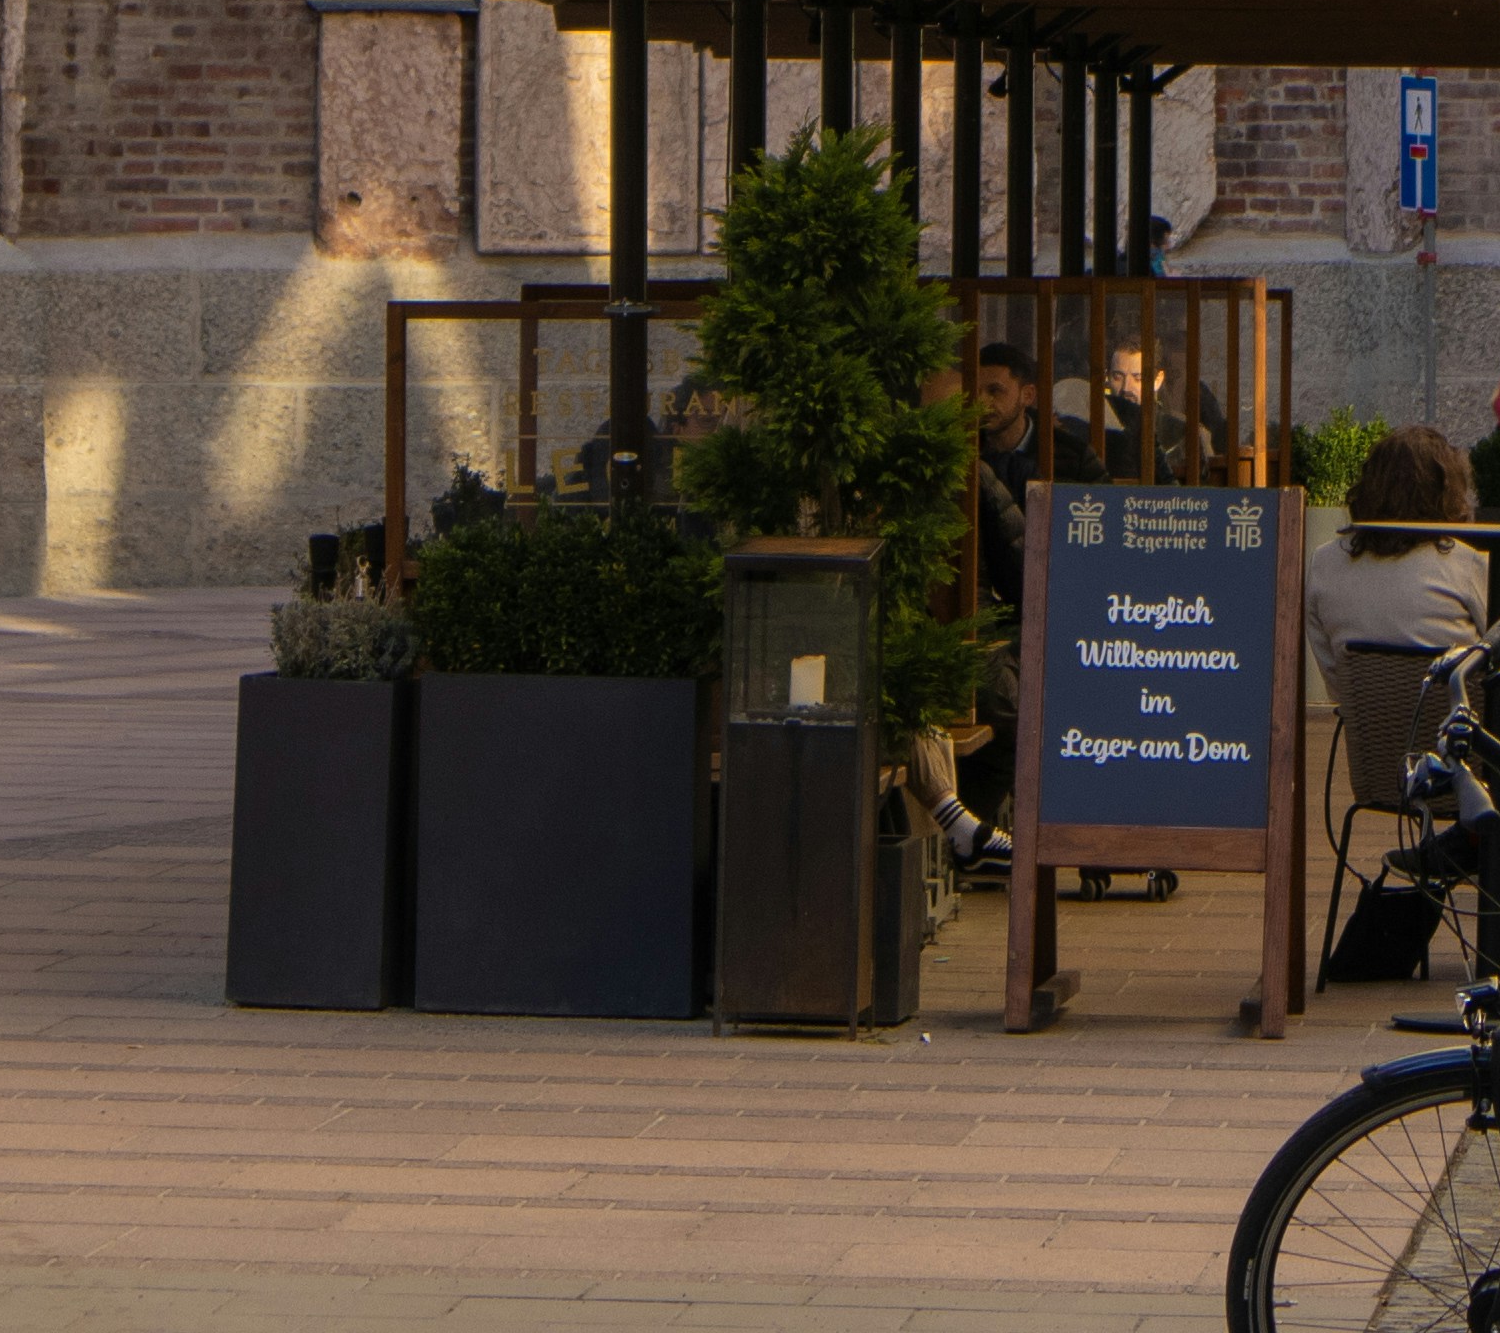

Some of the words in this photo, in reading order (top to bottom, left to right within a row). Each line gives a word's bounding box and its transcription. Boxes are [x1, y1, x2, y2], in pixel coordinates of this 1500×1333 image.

[1123, 496, 1209, 514] Herzogliches
[1123, 513, 1208, 534] Brauhaus
[1122, 532, 1207, 553] Tegernsee
[1107, 594, 1214, 630] Herzlich
[1076, 640, 1240, 670] Willkommen
[1140, 688, 1176, 715] im
[1060, 728, 1137, 764] Leger
[1139, 739, 1184, 760] am
[1186, 733, 1250, 762] Dom
